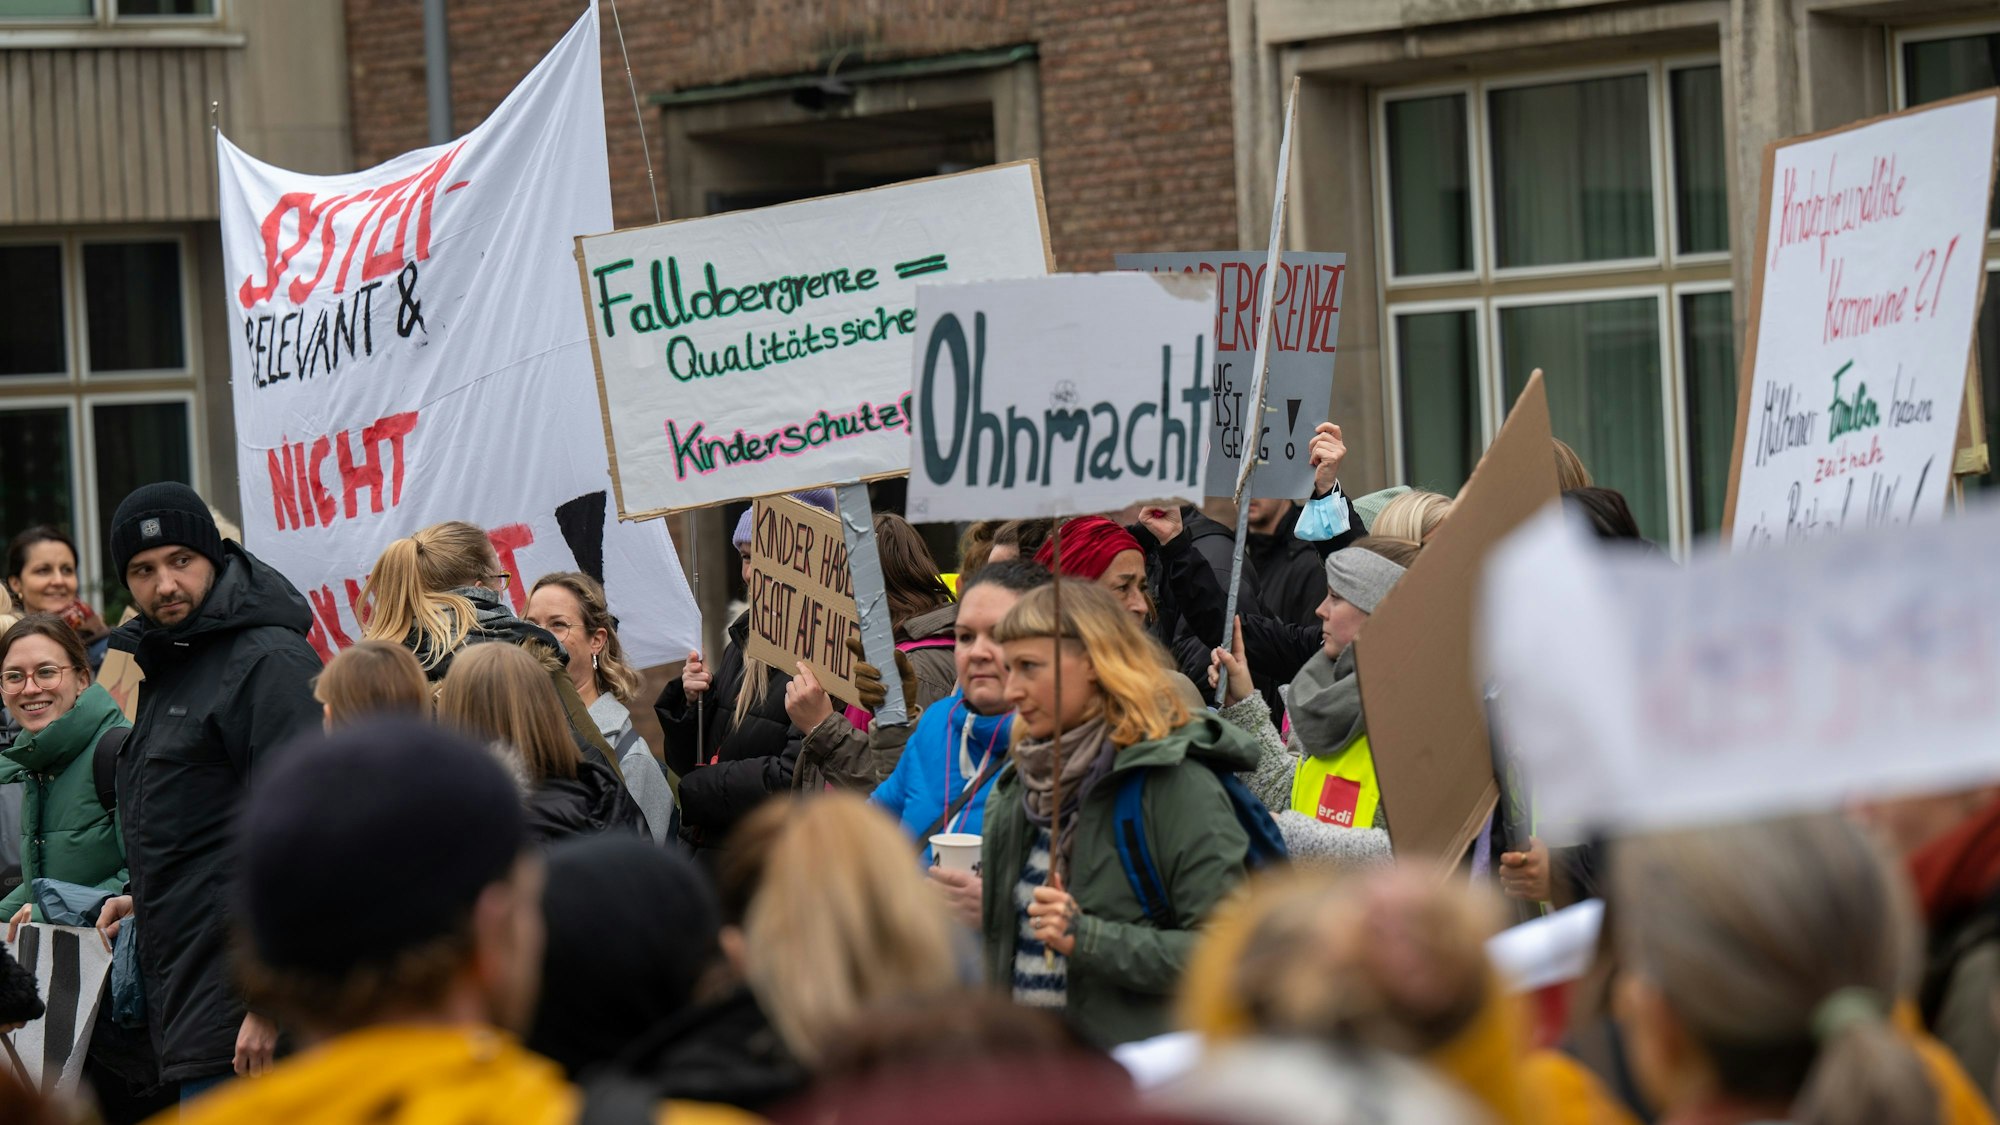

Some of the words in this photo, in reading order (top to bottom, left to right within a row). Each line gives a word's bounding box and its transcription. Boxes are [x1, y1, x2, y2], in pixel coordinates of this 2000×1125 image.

[246, 281, 382, 388] RELEVANT
[397, 260, 427, 338] &
[666, 307, 917, 382] Qualitätssiche
[1118, 262, 1345, 353] ERGRENZE
[920, 311, 1210, 489] Ohnmacht
[1214, 392, 1242, 427] IST
[267, 411, 418, 532] NICHT
[1222, 427, 1270, 461] GEG
[756, 501, 814, 578] KINDER
[794, 594, 823, 664] AUF
